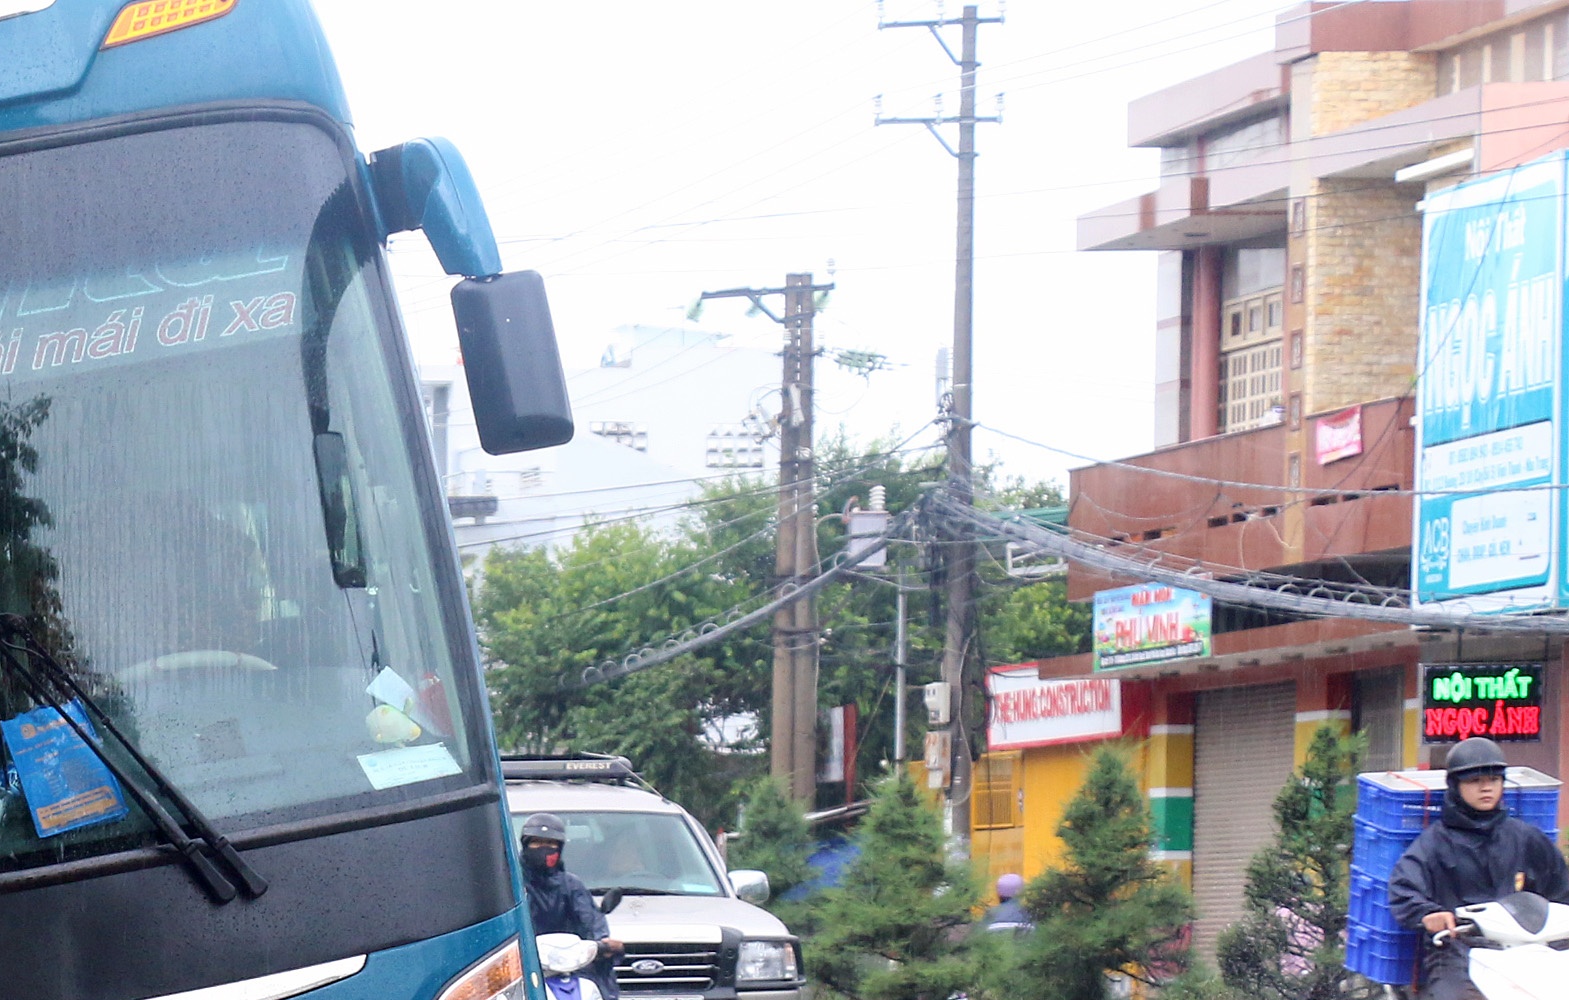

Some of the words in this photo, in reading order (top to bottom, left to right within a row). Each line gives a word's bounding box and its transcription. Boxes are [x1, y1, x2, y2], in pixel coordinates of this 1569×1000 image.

[32, 307, 144, 370] mái
[157, 294, 214, 347] đi
[221, 291, 297, 338] xa
[1425, 288, 1496, 429] NGỌC
[1040, 678, 1112, 718] CONSTRUCTION
[1433, 672, 1472, 703] NỘI
[1473, 668, 1532, 699] THẤT
[1425, 707, 1488, 741] NGỌC
[565, 762, 611, 770] EVEREST
